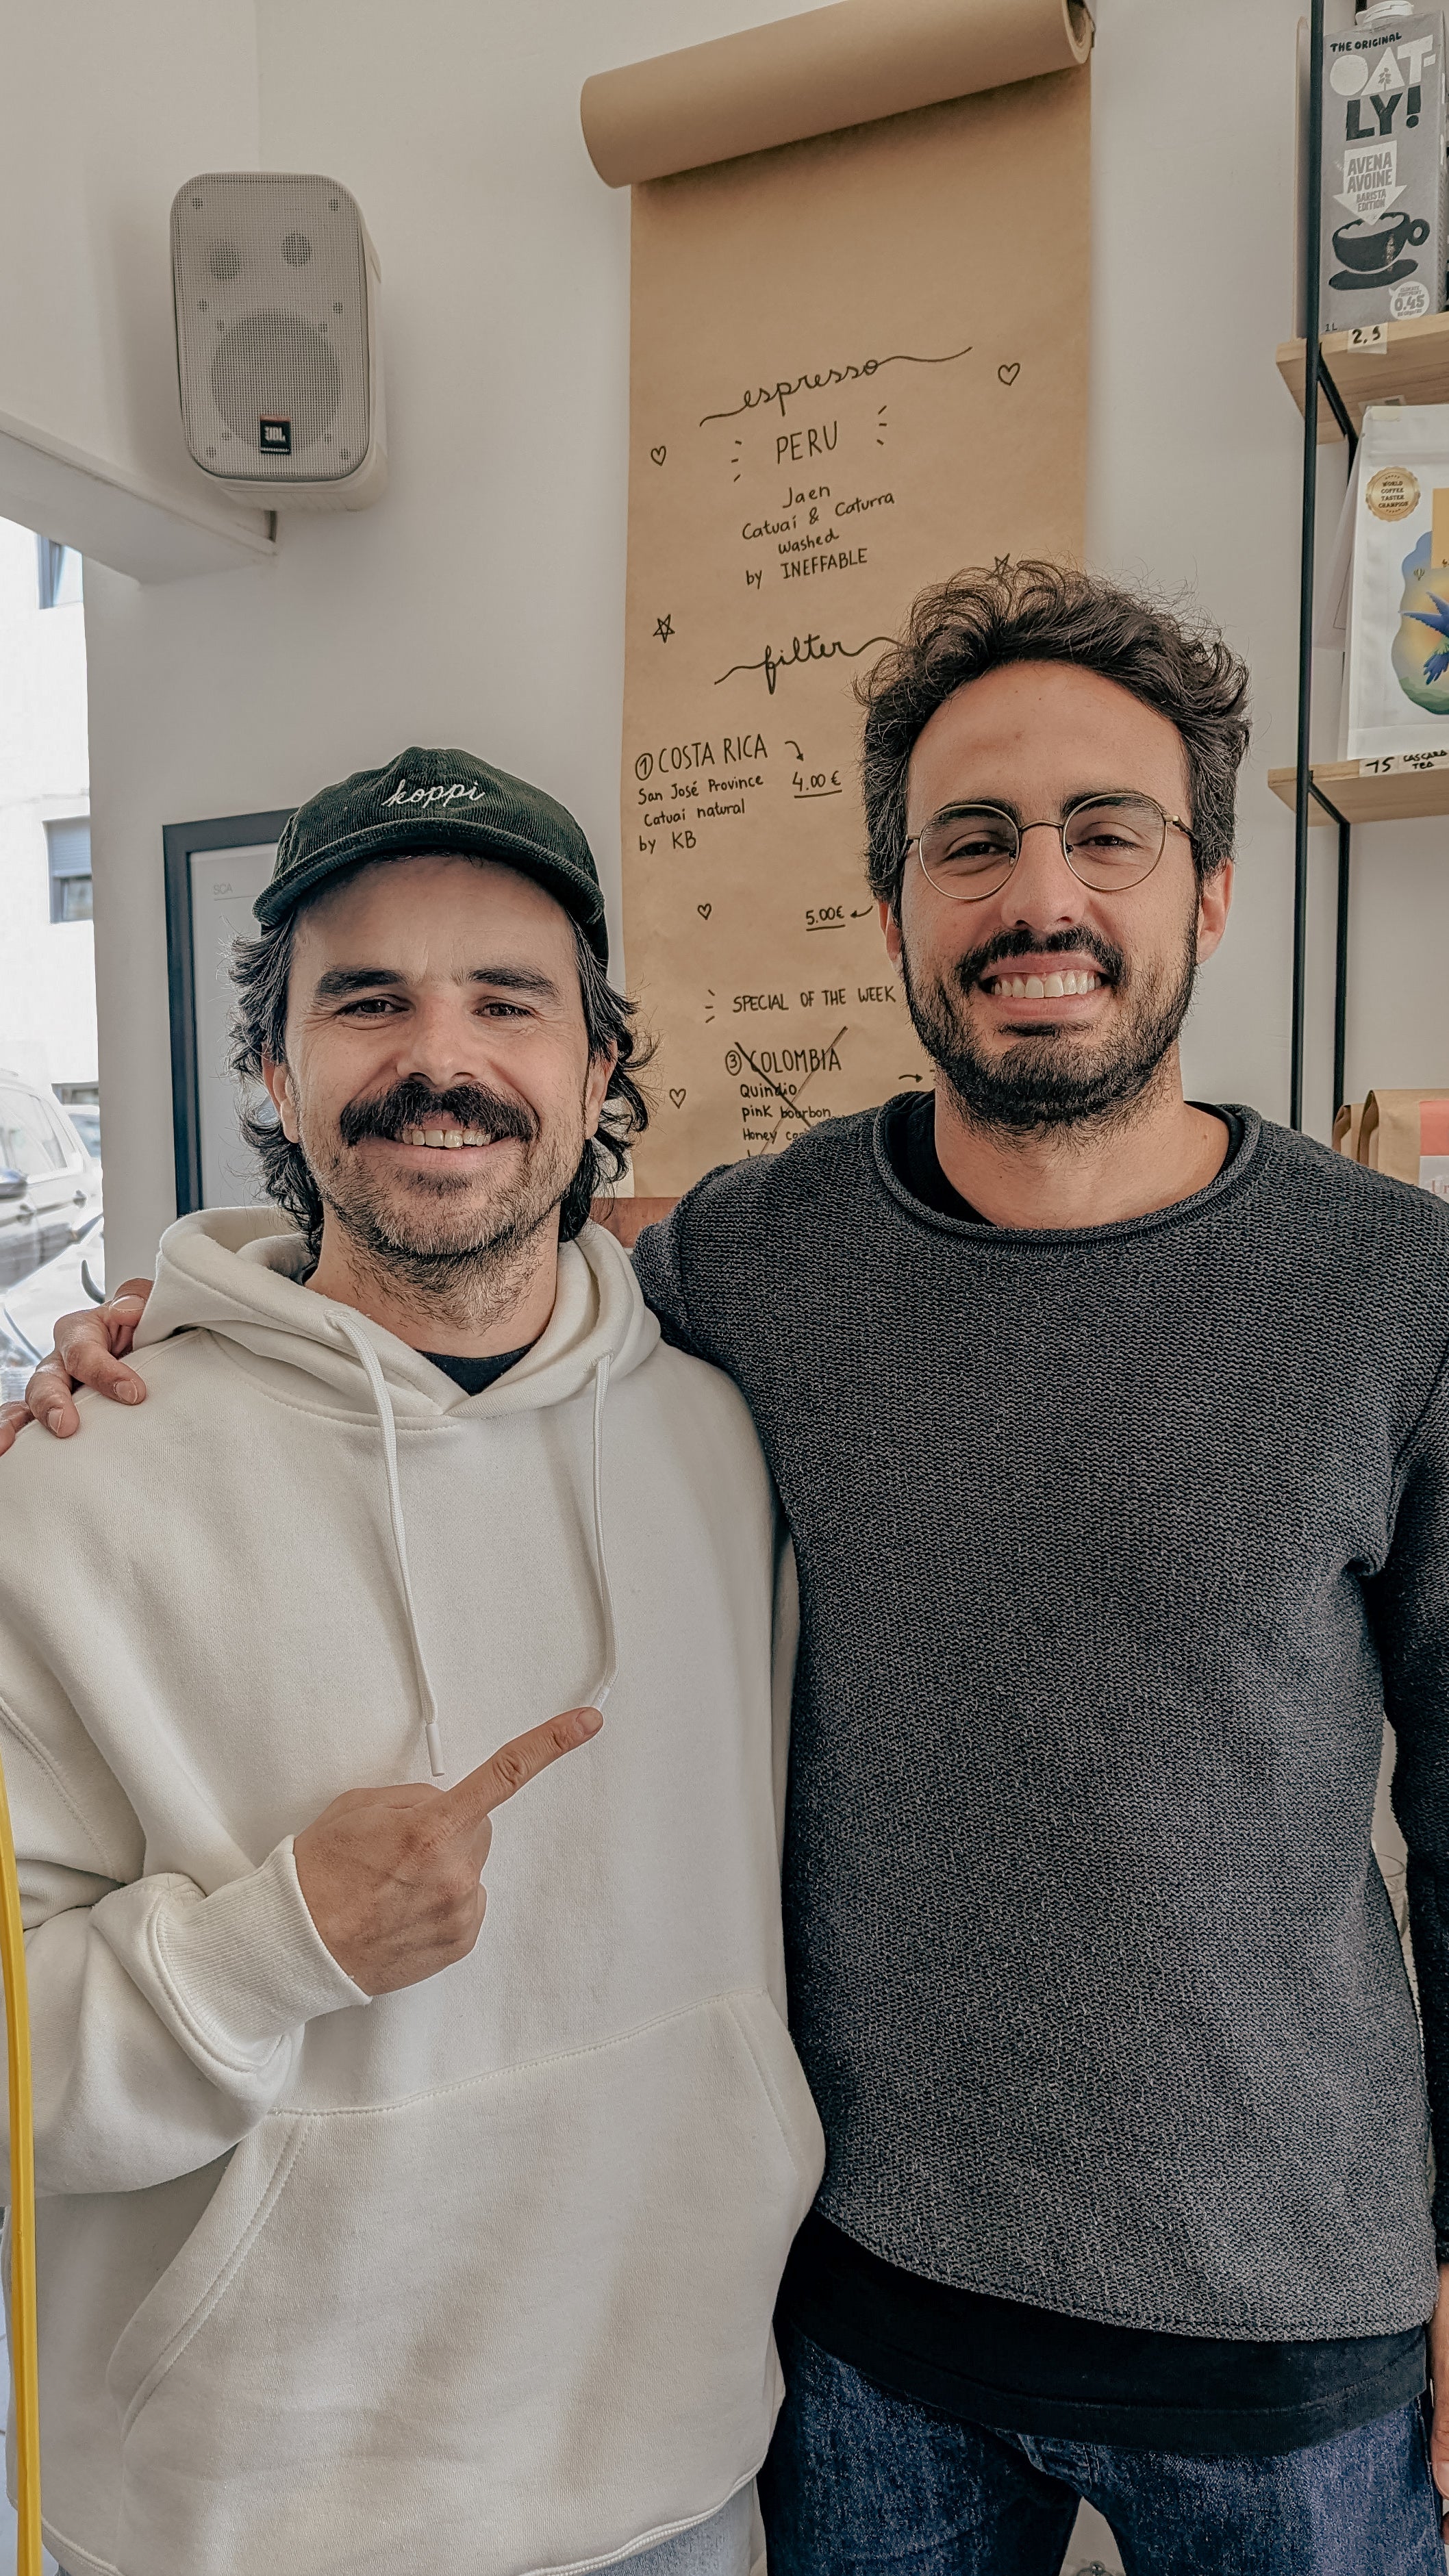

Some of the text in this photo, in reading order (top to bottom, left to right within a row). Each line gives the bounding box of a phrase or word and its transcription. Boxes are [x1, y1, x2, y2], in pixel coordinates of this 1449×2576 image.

[1330, 32, 1402, 52] THE ORIGINAL
[1346, 85, 1421, 141] LY!
[1347, 152, 1391, 176] AVENA
[1347, 168, 1392, 193] AVOINE
[1357, 189, 1386, 203] BARISTA
[1357, 199, 1385, 212] EDITION
[1394, 294, 1424, 311] 0.45
[742, 359, 881, 416] espresso
[777, 420, 837, 464] PERU
[782, 485, 831, 508] Jaen
[809, 507, 819, 525] &
[835, 492, 894, 516] Caturra
[746, 548, 868, 590] by INEFFABLE
[763, 633, 842, 695] filter
[659, 742, 715, 772] COSTA
[724, 734, 768, 763] RICA
[381, 779, 486, 809] koppi
[638, 776, 764, 805] San José Province
[697, 798, 745, 818] natural
[639, 831, 696, 855] by KB
[733, 986, 896, 1013] SPECIAL OF THE WEEK
[750, 1048, 842, 1074] COLOMBIA
[742, 1105, 831, 1122] pink bourbon
[743, 1128, 777, 1145] Honey
